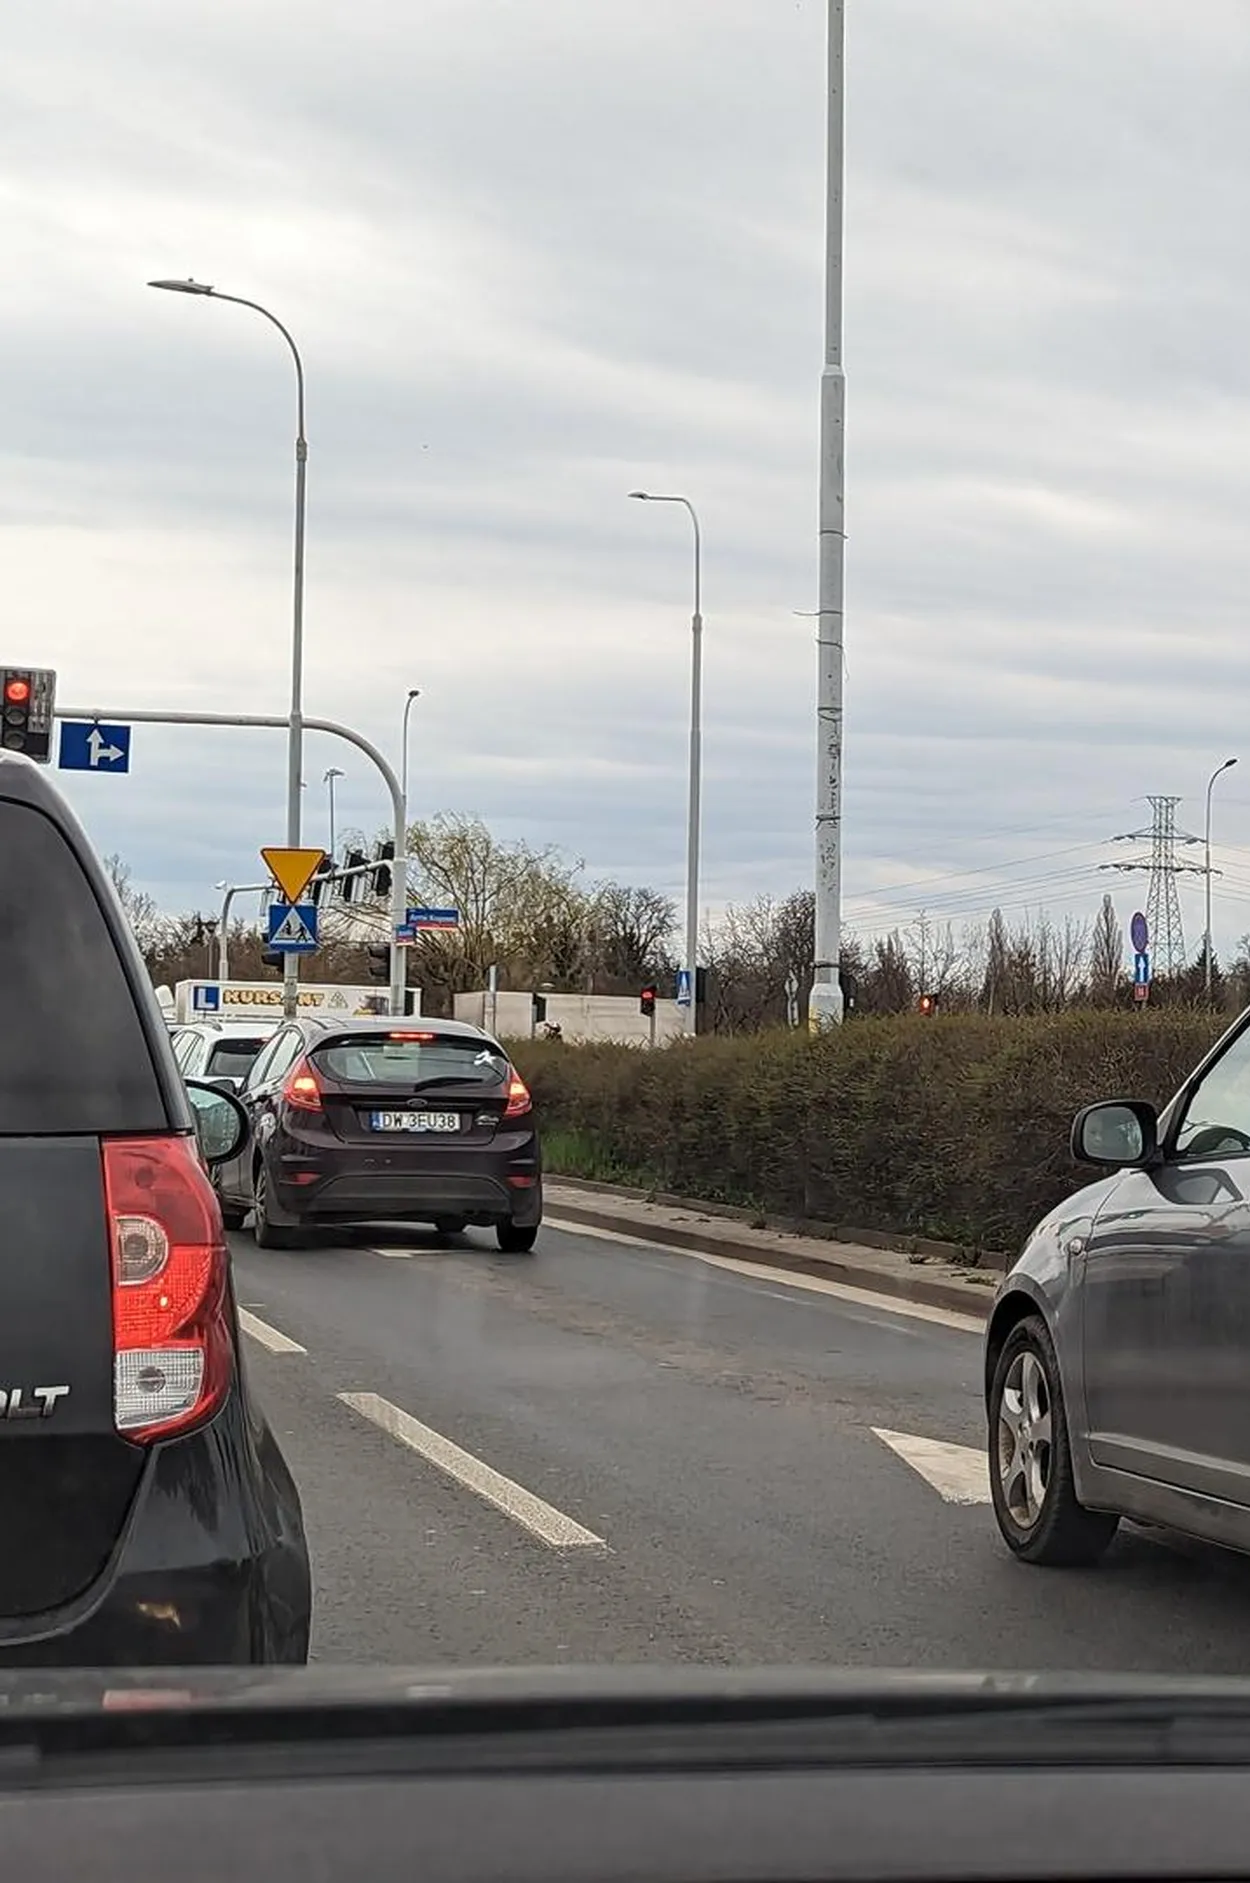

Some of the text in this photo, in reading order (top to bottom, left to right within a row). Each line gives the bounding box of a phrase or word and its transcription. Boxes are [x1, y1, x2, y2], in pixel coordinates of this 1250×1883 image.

[195, 987, 215, 1009] L
[223, 989, 325, 1007] KURSNT
[383, 1113, 401, 1128] DW
